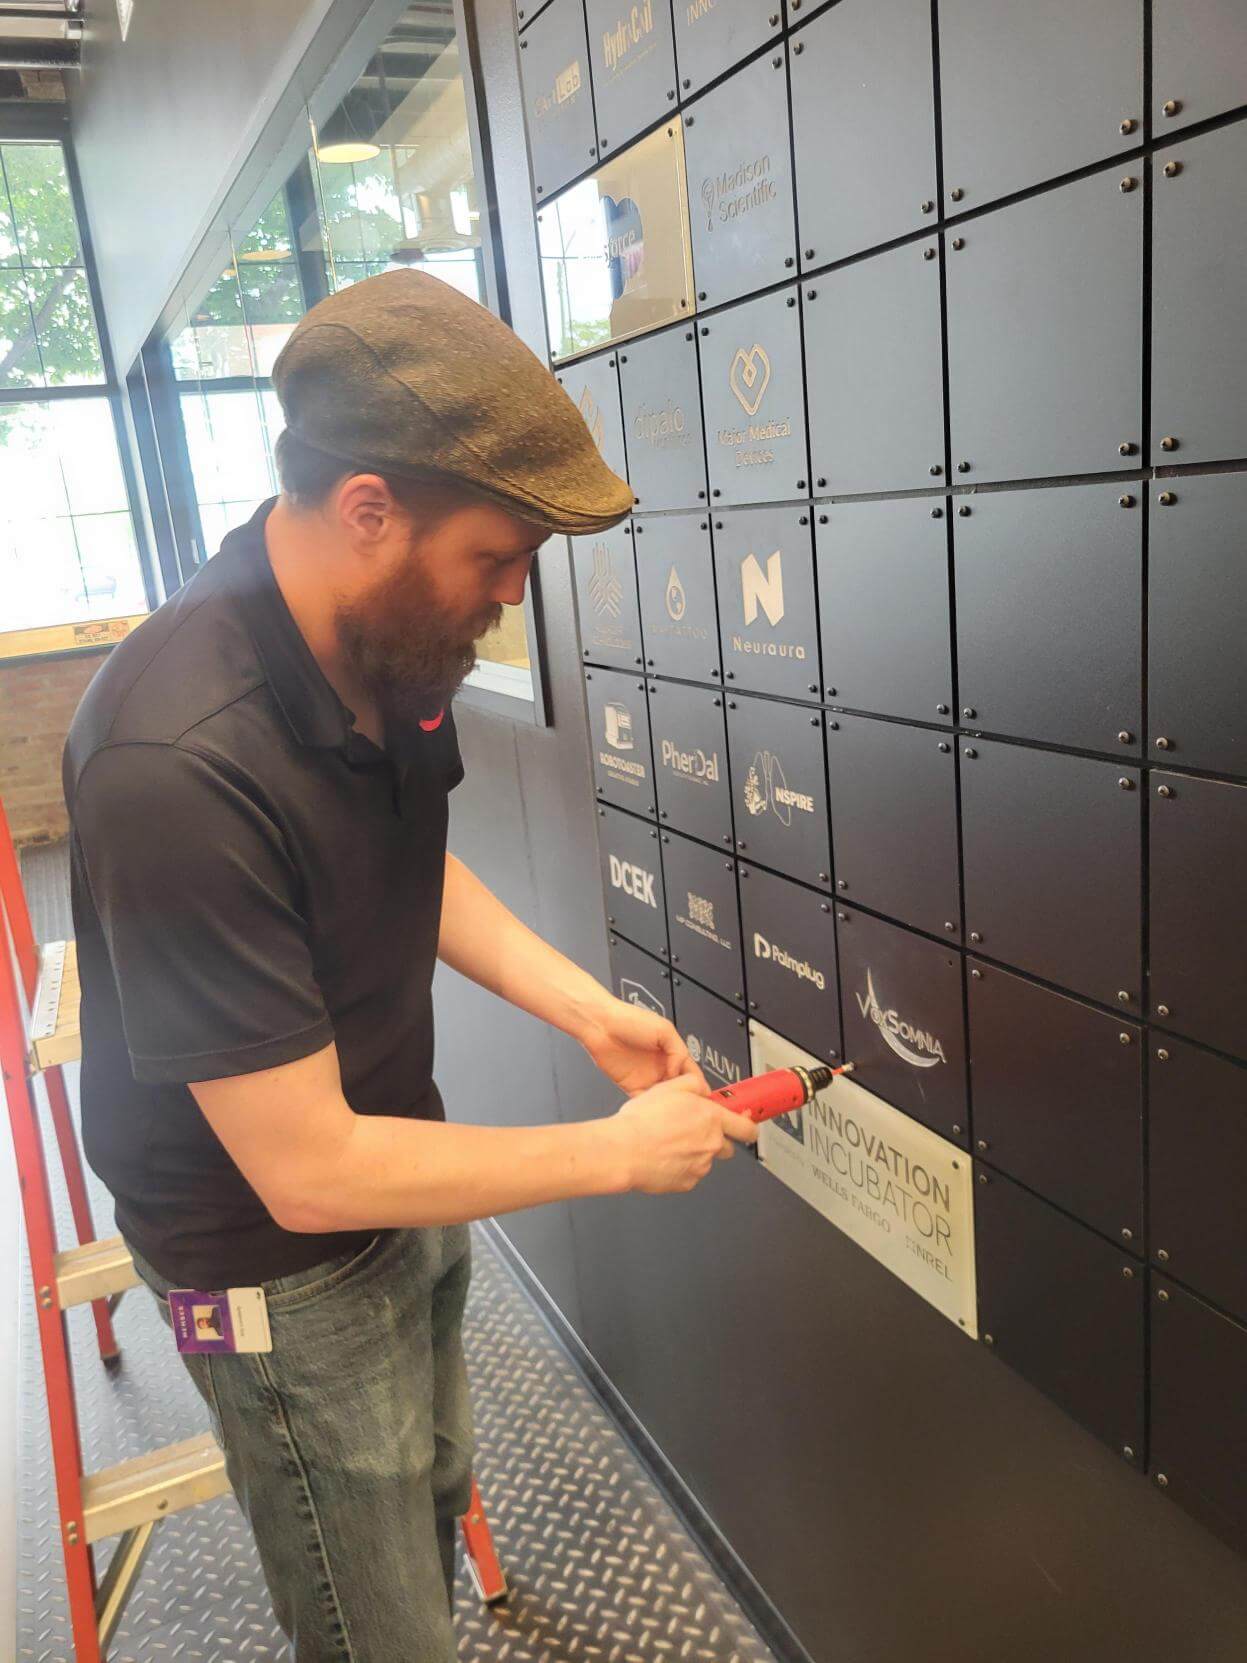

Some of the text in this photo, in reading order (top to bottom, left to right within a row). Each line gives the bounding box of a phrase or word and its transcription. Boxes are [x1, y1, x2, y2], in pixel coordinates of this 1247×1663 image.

[716, 154, 770, 195] Madison
[719, 178, 777, 222] Scientific
[717, 428, 746, 448] Major
[748, 416, 791, 440] Medical
[732, 634, 806, 660] Neuraura
[662, 739, 719, 782] PherDal
[609, 854, 658, 910] DCEK
[771, 944, 826, 991] Palmplug
[808, 1097, 950, 1213] INNOVATION
[809, 1123, 953, 1257] INCUBATOR
[812, 1164, 849, 1201] WELLS
[851, 1194, 891, 1234] FARGO
